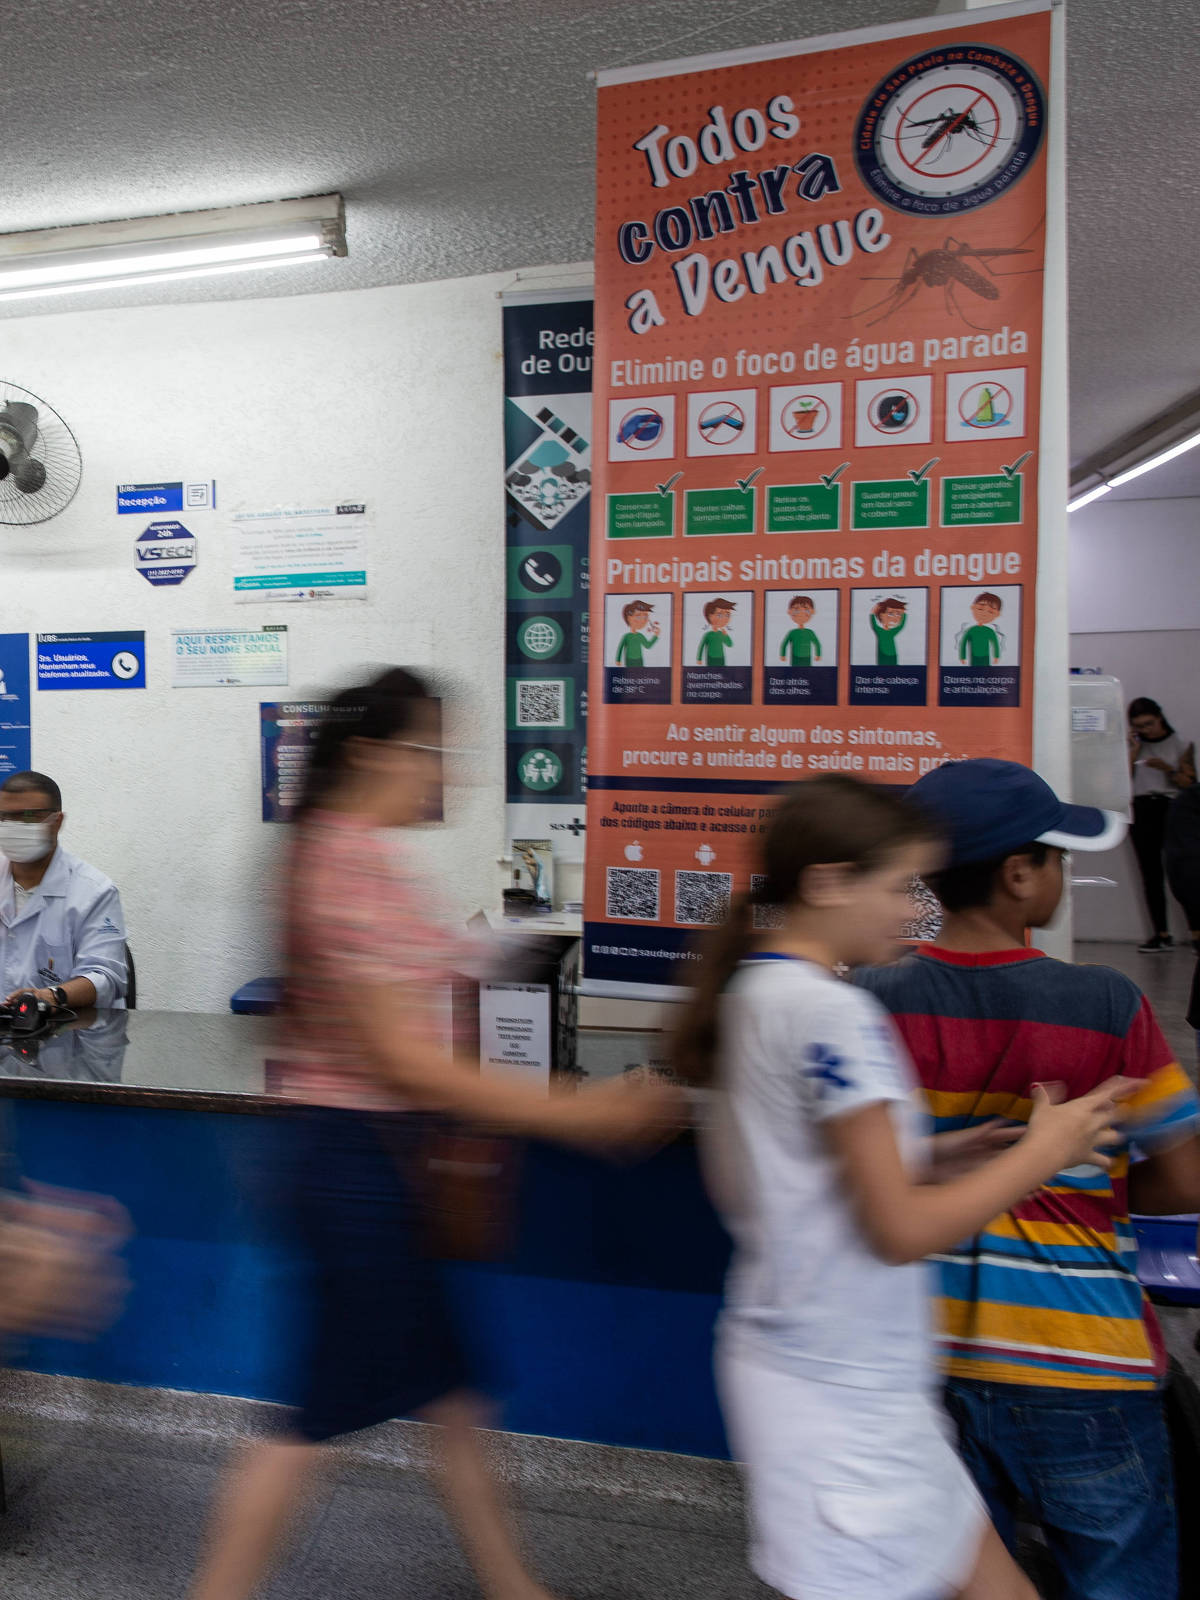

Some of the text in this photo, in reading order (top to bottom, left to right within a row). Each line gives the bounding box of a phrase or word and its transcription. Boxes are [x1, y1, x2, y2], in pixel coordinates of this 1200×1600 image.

[906, 52, 945, 74] Paulo
[947, 51, 964, 60] no
[966, 50, 1019, 77] Combate
[1020, 83, 1040, 127] Dengue
[635, 95, 800, 187] Todos
[869, 167, 903, 200] Elimine
[911, 200, 941, 212] foco
[942, 198, 960, 211] de
[962, 183, 994, 207] água
[992, 151, 1028, 191] parada
[618, 152, 843, 265] contra
[626, 207, 893, 335] a Dengue
[539, 326, 595, 350] Rede
[610, 326, 1029, 388] Elimine o foco de água parada
[521, 355, 552, 375] de
[118, 496, 167, 508] Recepção
[606, 548, 1021, 588] Principais sintomas da dengue
[176, 633, 280, 646] AQUI RESPEITAMOS
[176, 643, 282, 655] O SEU NOME SOCIAL
[39, 662, 79, 670] Mantenham
[39, 671, 69, 679] telefones
[687, 672, 723, 680] Manchas
[769, 676, 810, 685] Dor atrás
[855, 676, 920, 686] Dor de cabeça
[943, 675, 1015, 686] Dores no corpo
[687, 680, 744, 689] avermelhadas
[769, 686, 811, 695] dos olhos
[855, 686, 890, 694] intensa
[951, 685, 1009, 695] articulações
[687, 690, 722, 699] no corpo
[666, 723, 942, 749] Ao sentir algum dos sintomas,
[622, 749, 914, 772] procure a unidade de saúde mais
[612, 801, 756, 818] Aponte a câmera do celular
[600, 816, 618, 828] dos
[621, 817, 662, 831] códigos
[664, 818, 699, 831] abaixo
[700, 822, 708, 832] e
[709, 822, 748, 833] acesse
[749, 825, 756, 834] o
